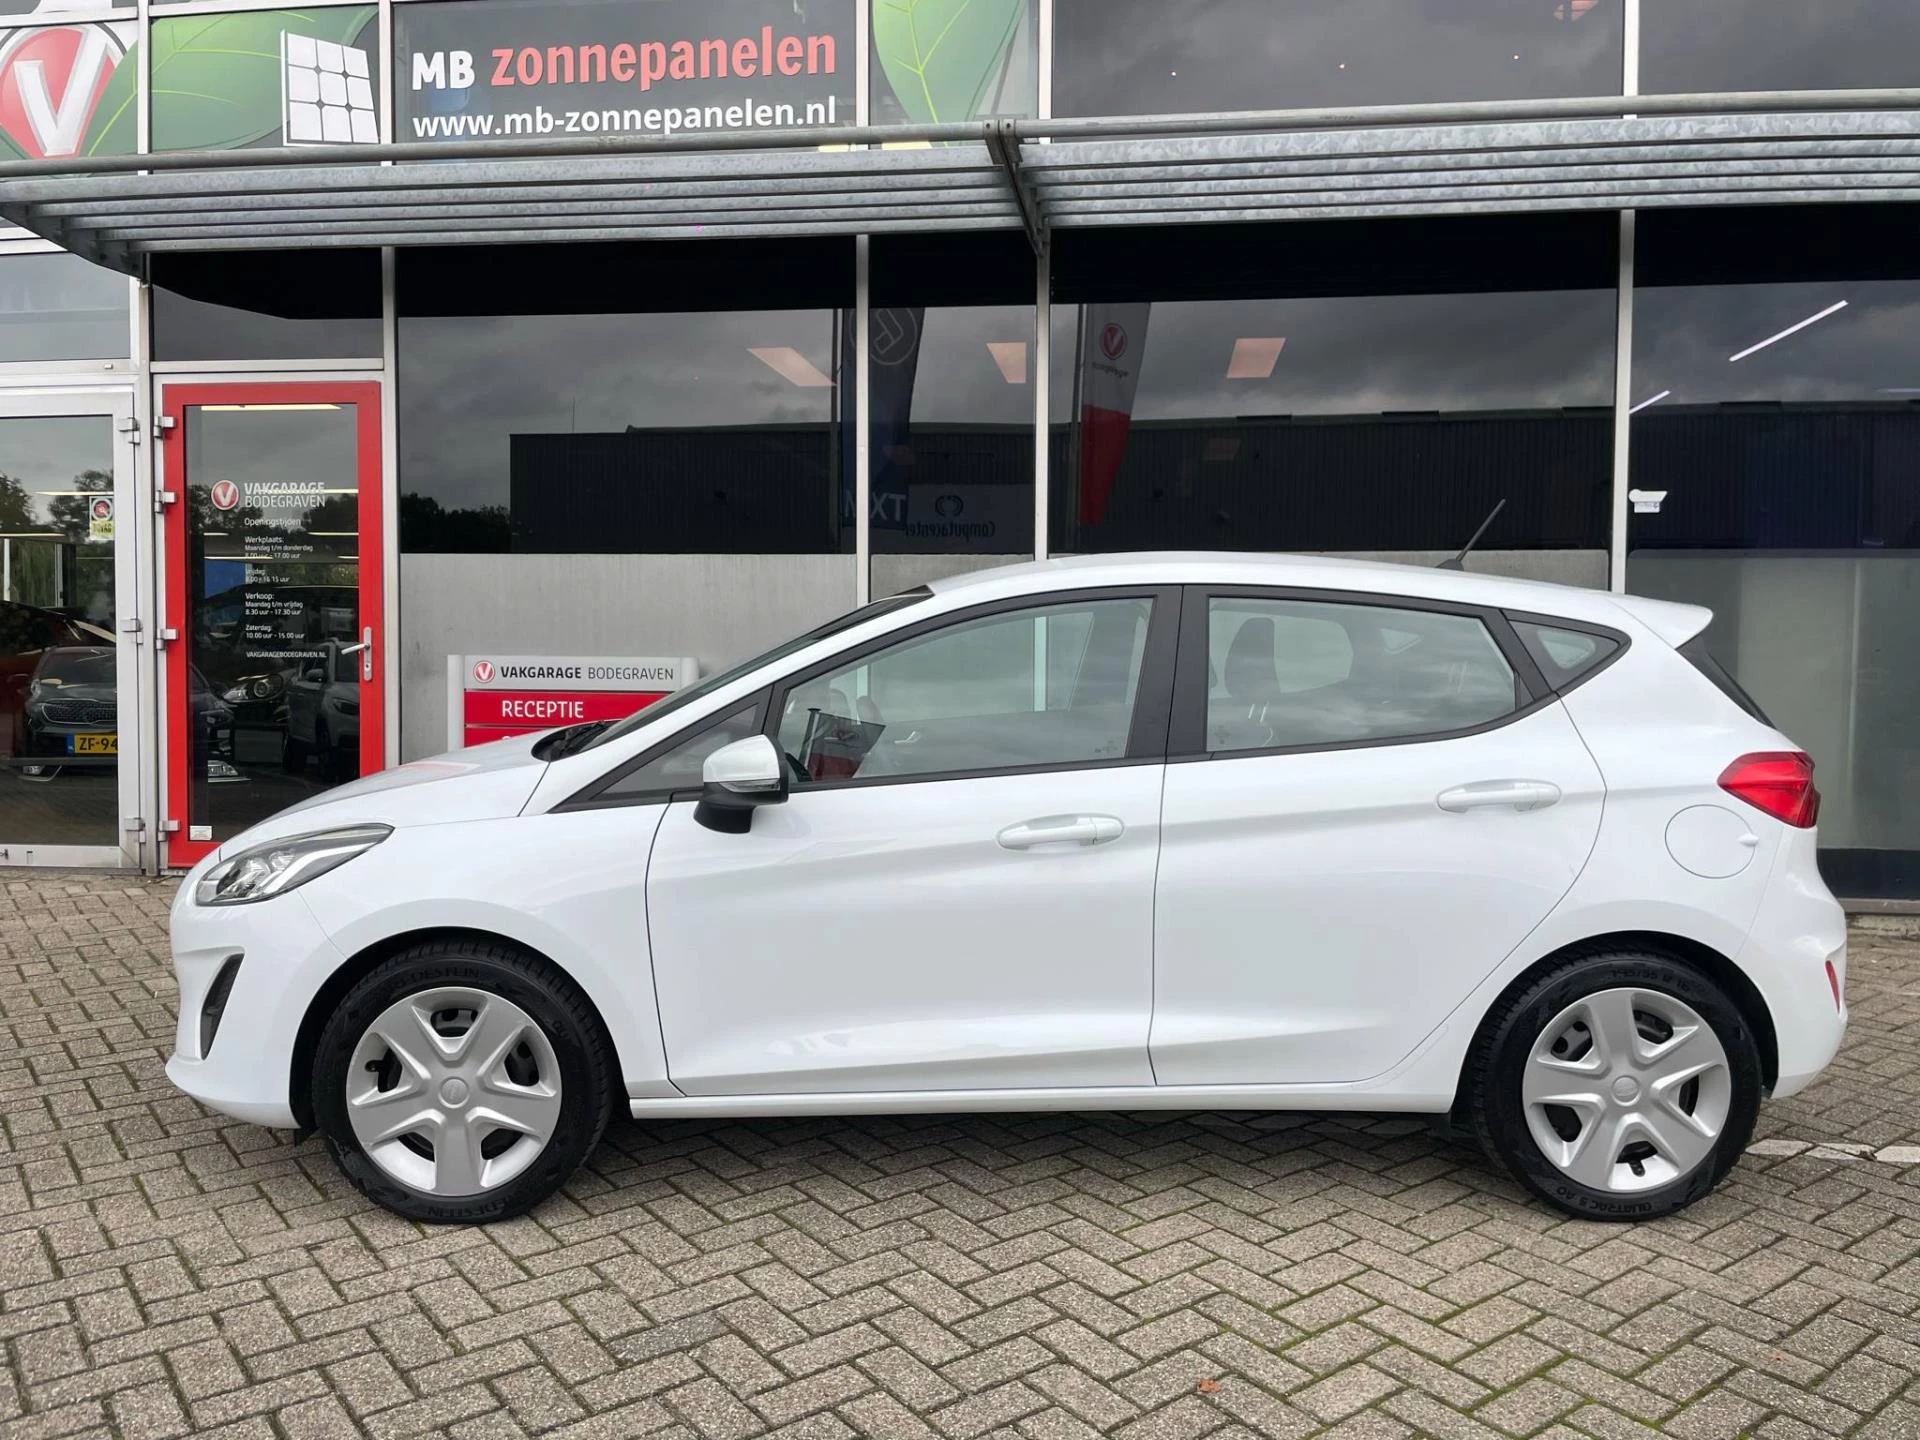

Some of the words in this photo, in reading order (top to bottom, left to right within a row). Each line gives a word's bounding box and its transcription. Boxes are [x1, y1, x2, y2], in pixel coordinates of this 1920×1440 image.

[411, 50, 475, 90] MB
[490, 25, 836, 92] zonnepanelen
[412, 95, 836, 138] www.mb-zonnepanelen.nl
[244, 482, 325, 495] VAKGARAGE
[244, 495, 326, 508] BODEGRAVEN
[244, 517, 301, 527] Openingstijden
[244, 536, 284, 544] Werkplaats:
[245, 592, 275, 601] Verkoop:
[245, 601, 271, 609] Maandag
[283, 601, 303, 609] vrijdag
[500, 666, 582, 679] VAKGARAGE
[587, 667, 674, 680] BODEGRAVEN
[502, 700, 584, 719] RECEPTIE
